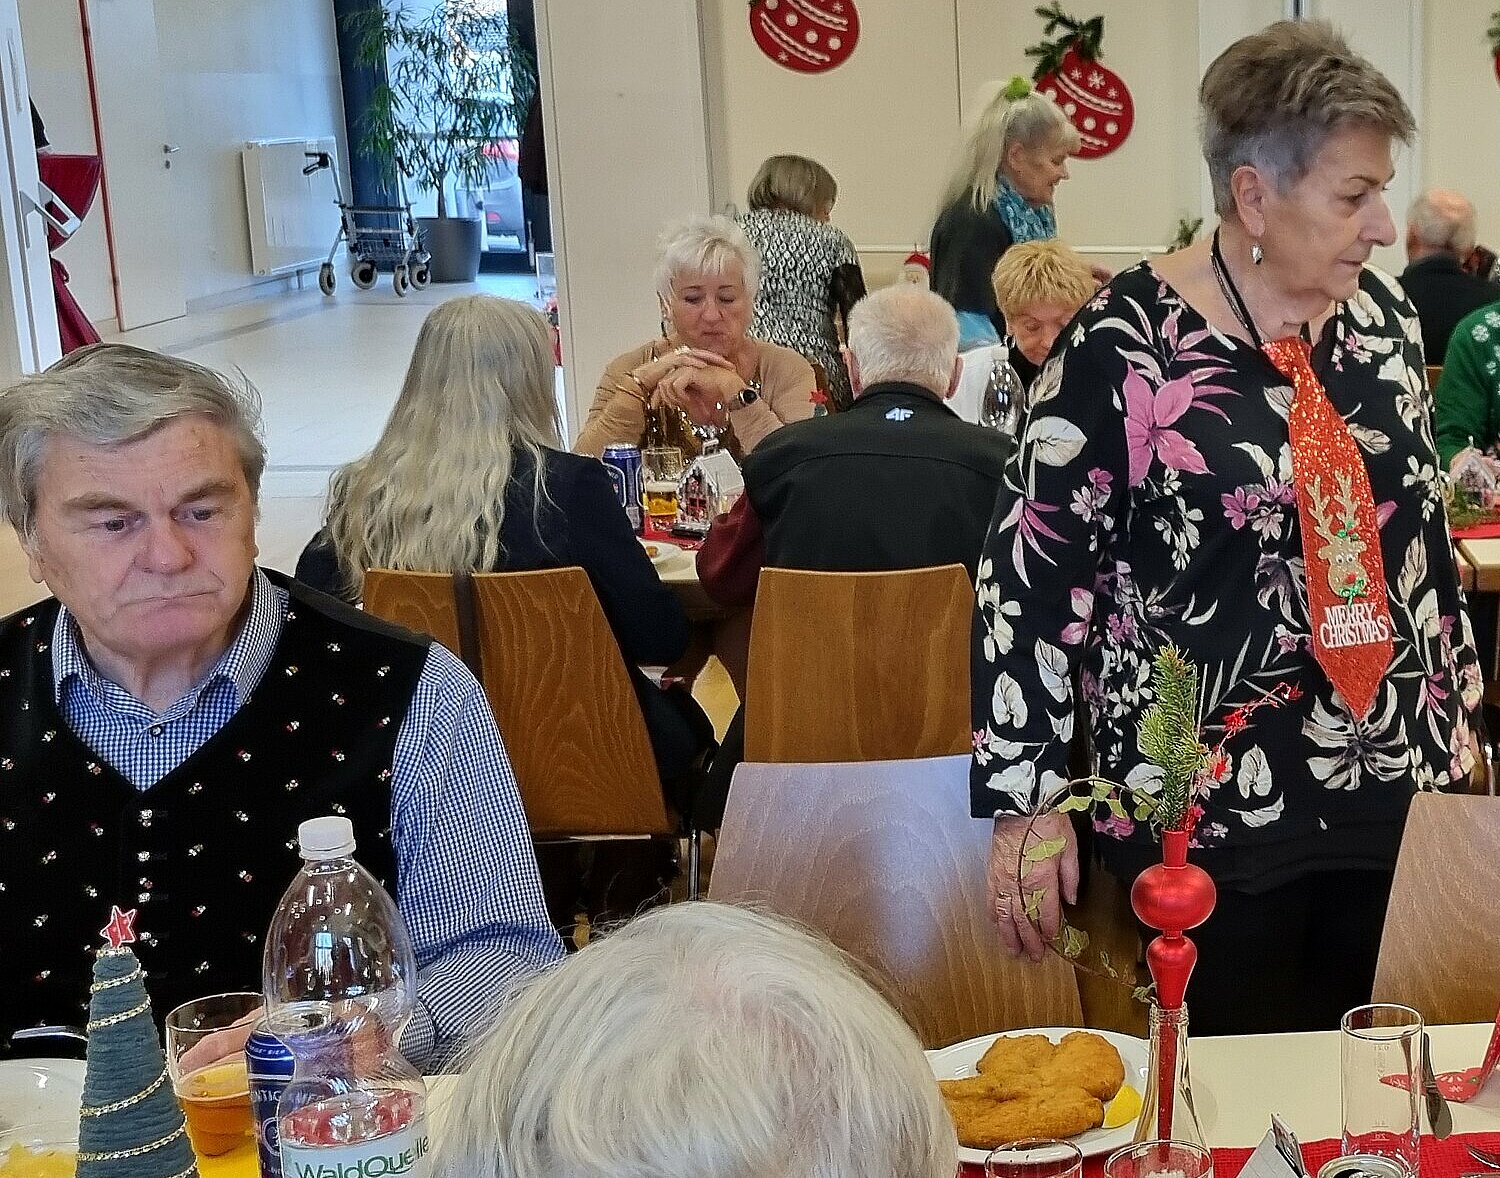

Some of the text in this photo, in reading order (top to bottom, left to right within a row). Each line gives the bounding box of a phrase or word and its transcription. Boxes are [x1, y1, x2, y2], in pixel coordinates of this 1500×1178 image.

[885, 407, 914, 421] 4F
[1324, 603, 1376, 627] MERRY
[1320, 615, 1388, 649] CHRISTMAS
